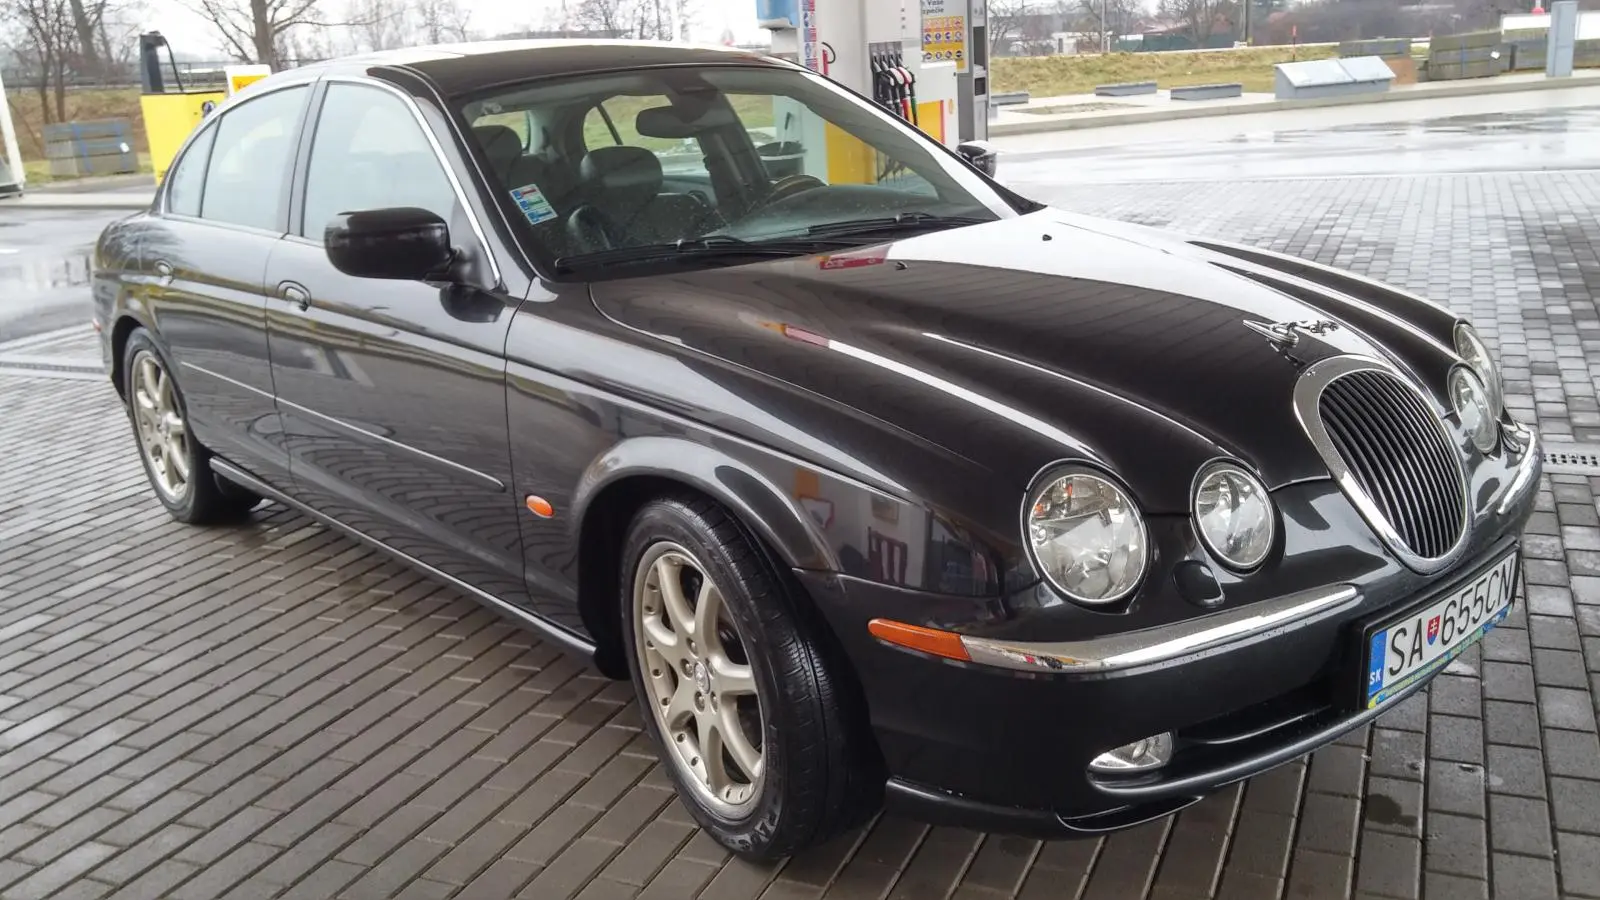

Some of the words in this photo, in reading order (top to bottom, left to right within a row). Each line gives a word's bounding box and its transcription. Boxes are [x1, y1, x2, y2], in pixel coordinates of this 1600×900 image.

[1389, 618, 1423, 676] SA
[1441, 558, 1513, 646] 655CN
[1369, 668, 1381, 685] SK
